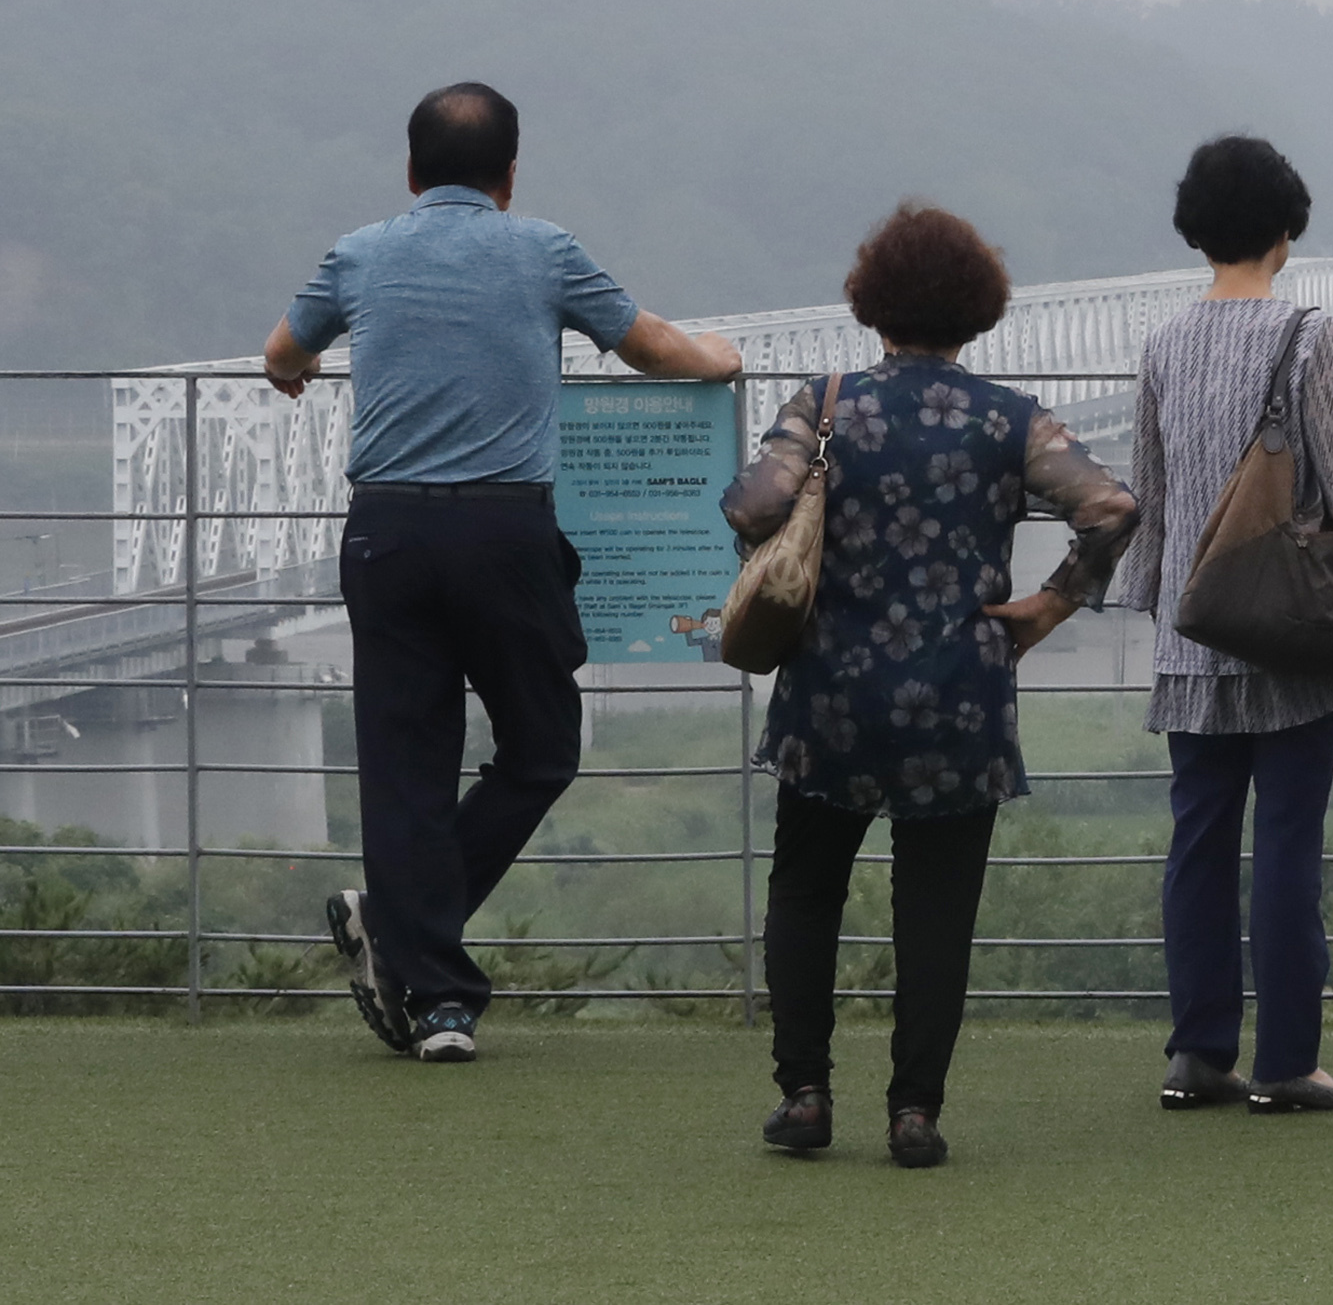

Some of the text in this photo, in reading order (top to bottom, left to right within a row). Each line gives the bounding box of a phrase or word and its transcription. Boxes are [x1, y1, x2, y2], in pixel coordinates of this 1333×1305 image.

[584, 396, 693, 414] 망원경 이용안내
[677, 477, 708, 486] BAGLE
[591, 510, 689, 522] Usage Instructions
